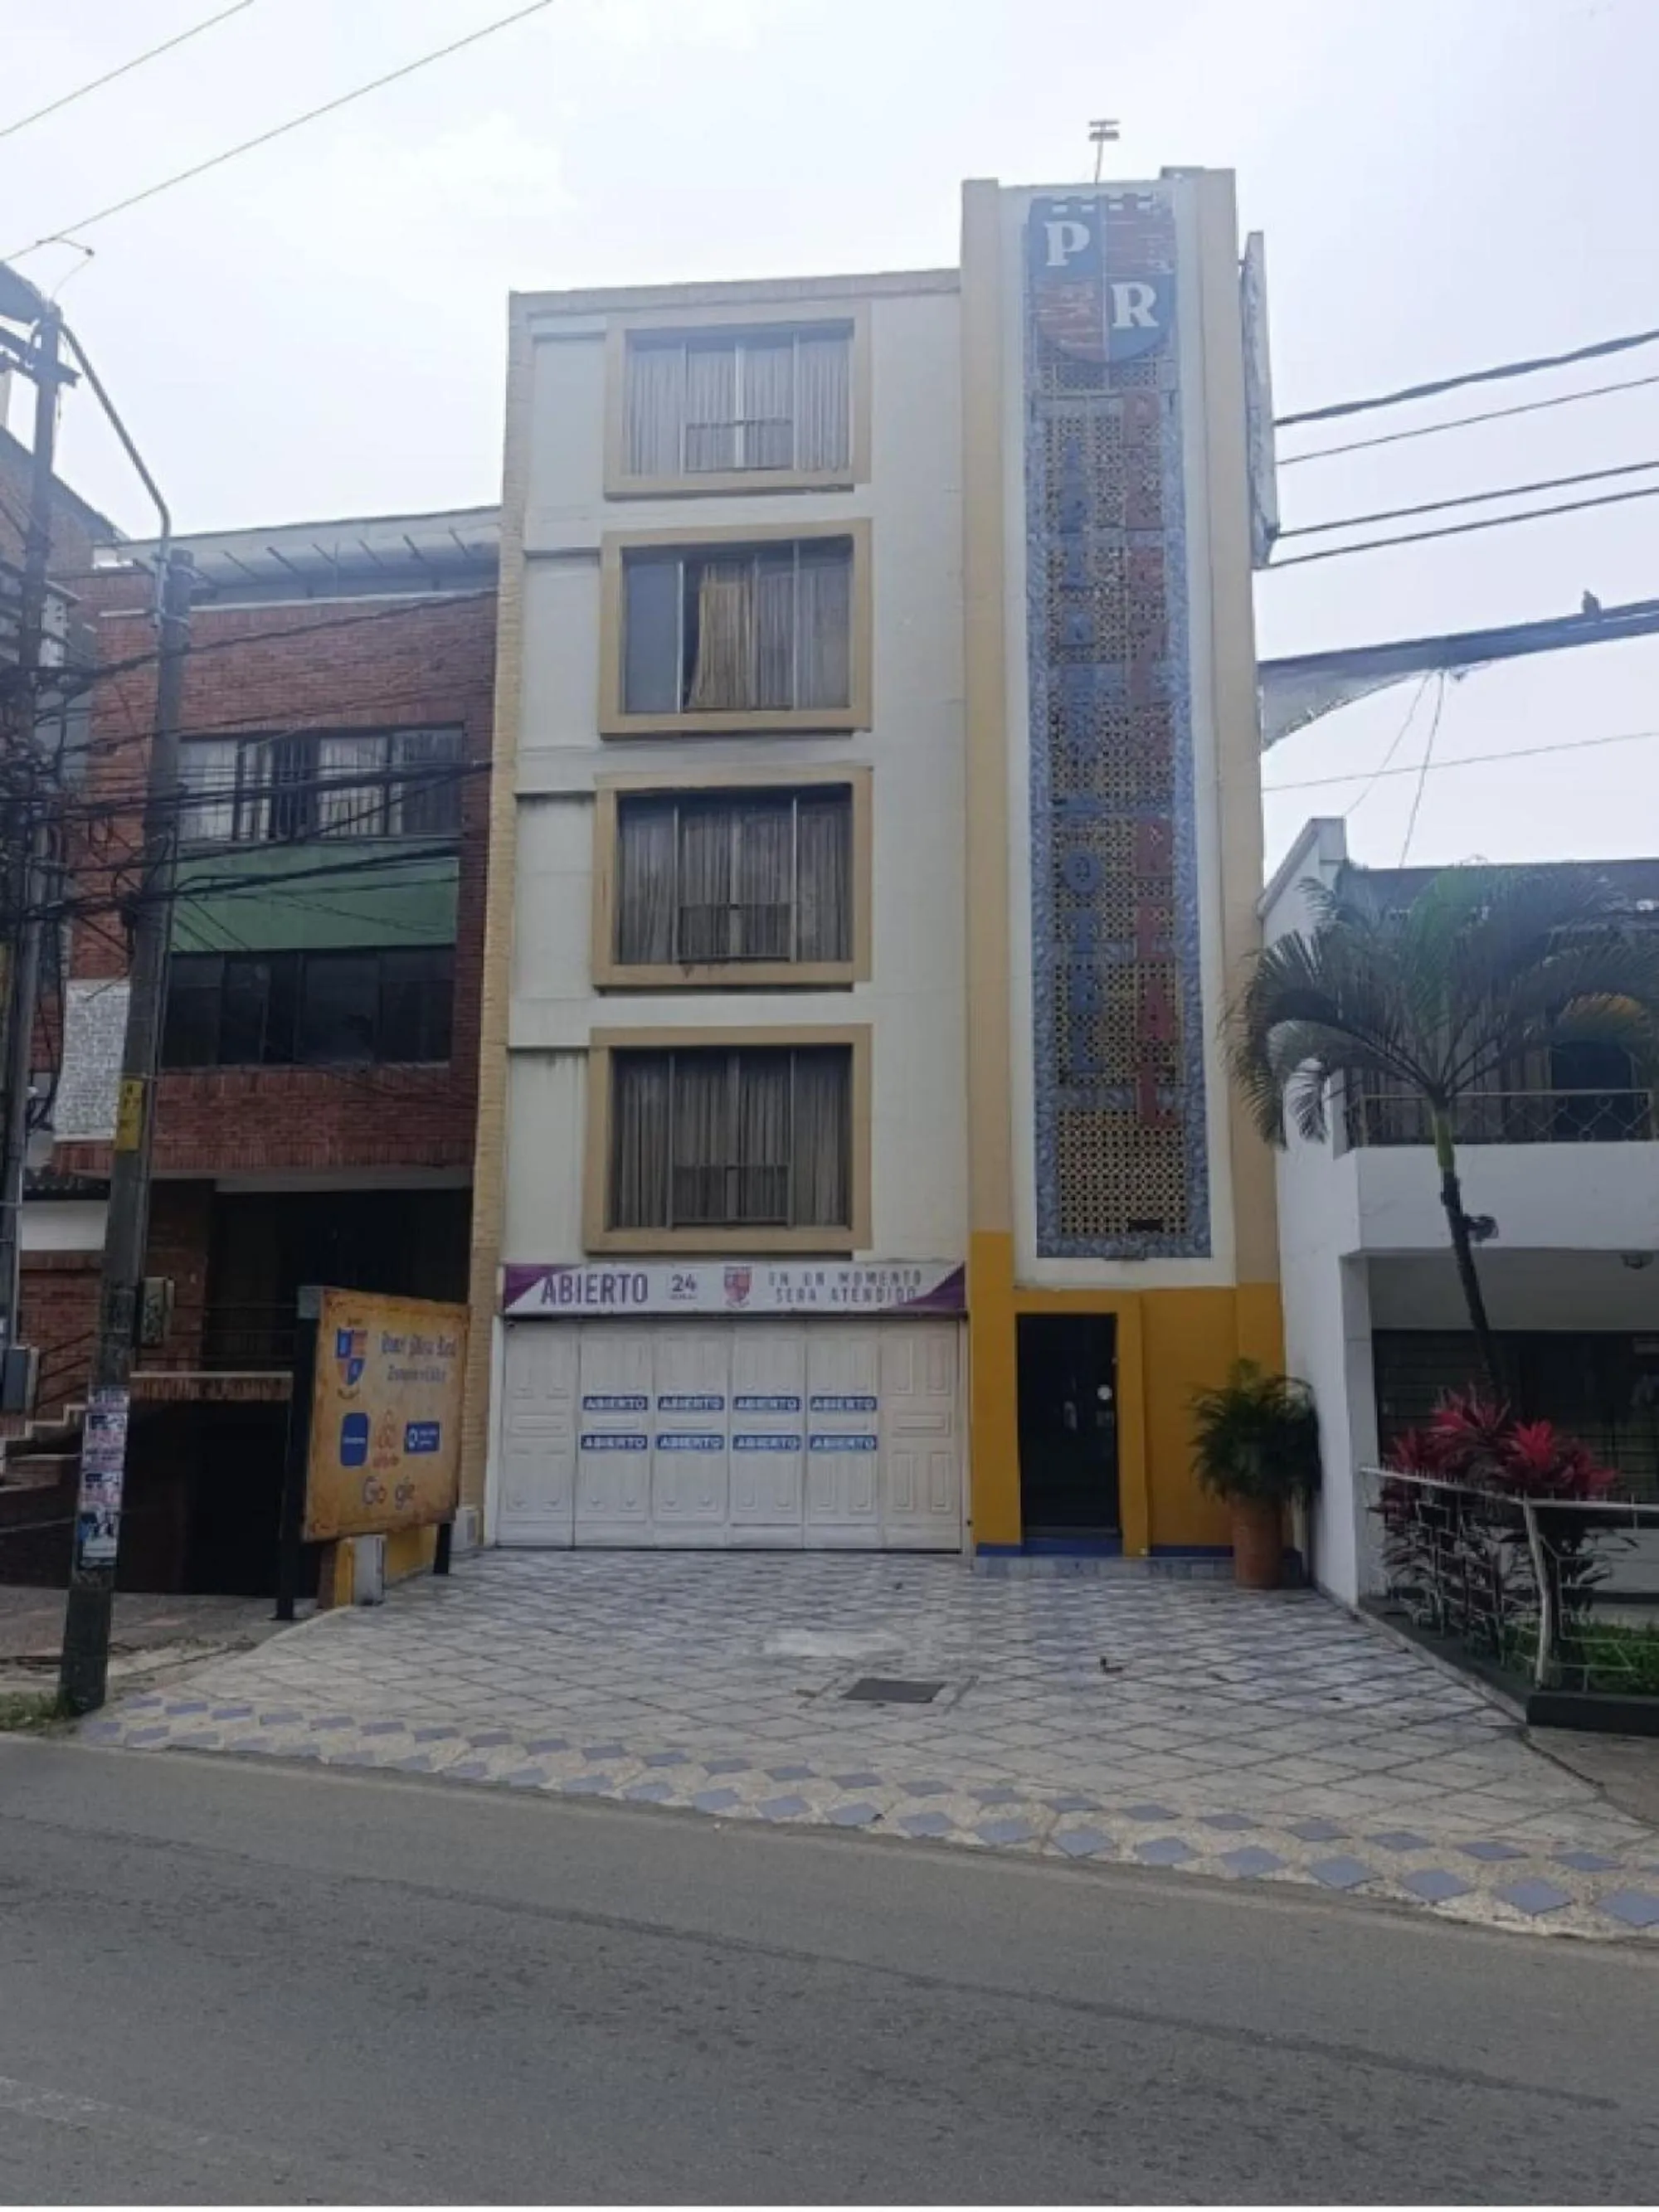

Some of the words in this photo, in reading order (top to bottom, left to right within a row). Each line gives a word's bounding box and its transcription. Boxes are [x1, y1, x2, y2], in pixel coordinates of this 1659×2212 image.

[1044, 220, 1091, 266] P
[1110, 280, 1160, 328] R
[672, 1273, 698, 1292] 24
[839, 1270, 922, 1286] MOMENTO
[541, 1273, 649, 1305] ABIERTO
[831, 1286, 916, 1303] ATENDIDO
[586, 1398, 645, 1409] ABIERTO
[660, 1398, 722, 1409] ABIERTO
[737, 1398, 798, 1410] ABIERTO
[813, 1398, 875, 1410] ABIERTO
[583, 1437, 645, 1449] ABIERTO
[659, 1437, 722, 1449] ABIERTO
[736, 1437, 798, 1449] ABIERTO
[813, 1437, 875, 1449] ABIERTO
[362, 1475, 416, 1510] Gogle
